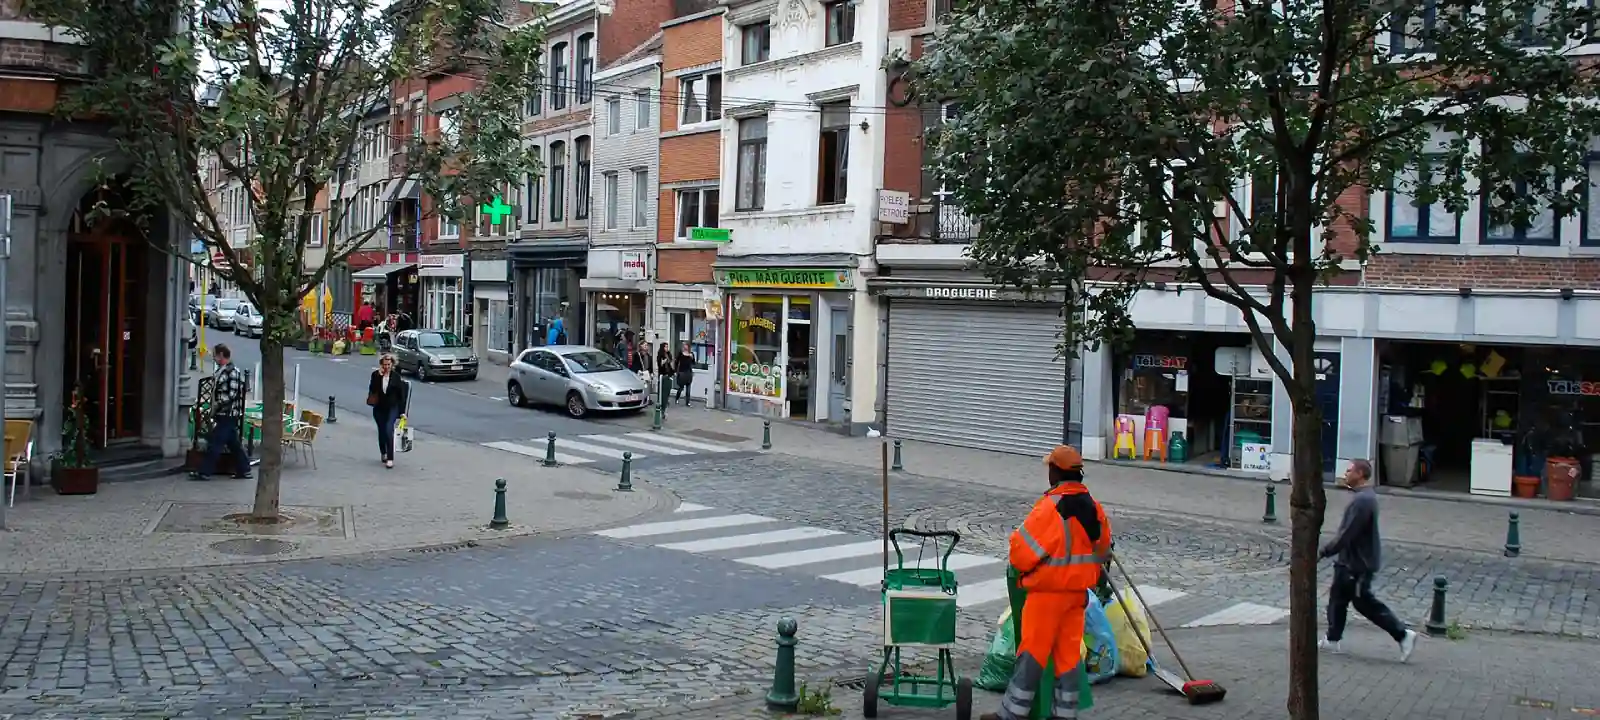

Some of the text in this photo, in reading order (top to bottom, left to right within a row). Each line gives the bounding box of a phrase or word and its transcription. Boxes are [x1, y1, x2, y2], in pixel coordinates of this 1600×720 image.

[623, 252, 646, 278] mady
[755, 271, 827, 285] MARGUERITE
[925, 287, 997, 299] DROGUERIE
